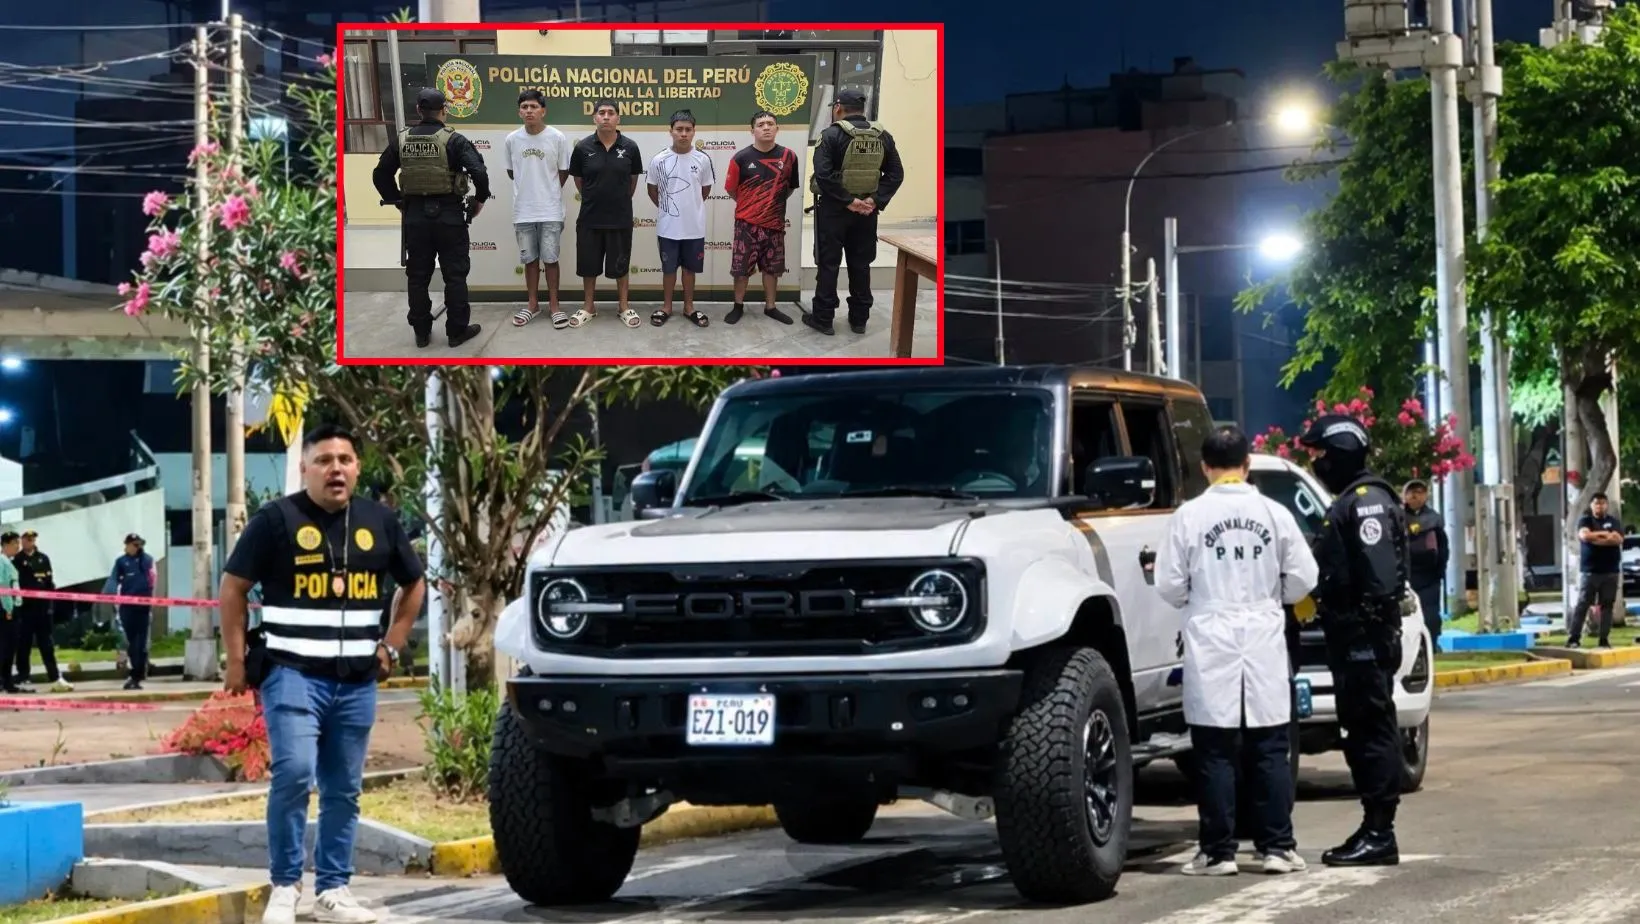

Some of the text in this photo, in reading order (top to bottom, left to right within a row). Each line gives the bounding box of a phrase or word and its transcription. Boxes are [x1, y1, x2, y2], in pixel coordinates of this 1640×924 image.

[488, 64, 750, 84] POLICÍA NACIONAL DEL PERÚ
[574, 86, 633, 98] POLICIAL
[637, 87, 653, 98] LA
[658, 87, 721, 98] LIBERTAD
[583, 101, 660, 116] DNCRI
[405, 143, 437, 153] POLICIA
[625, 589, 857, 619] FORD
